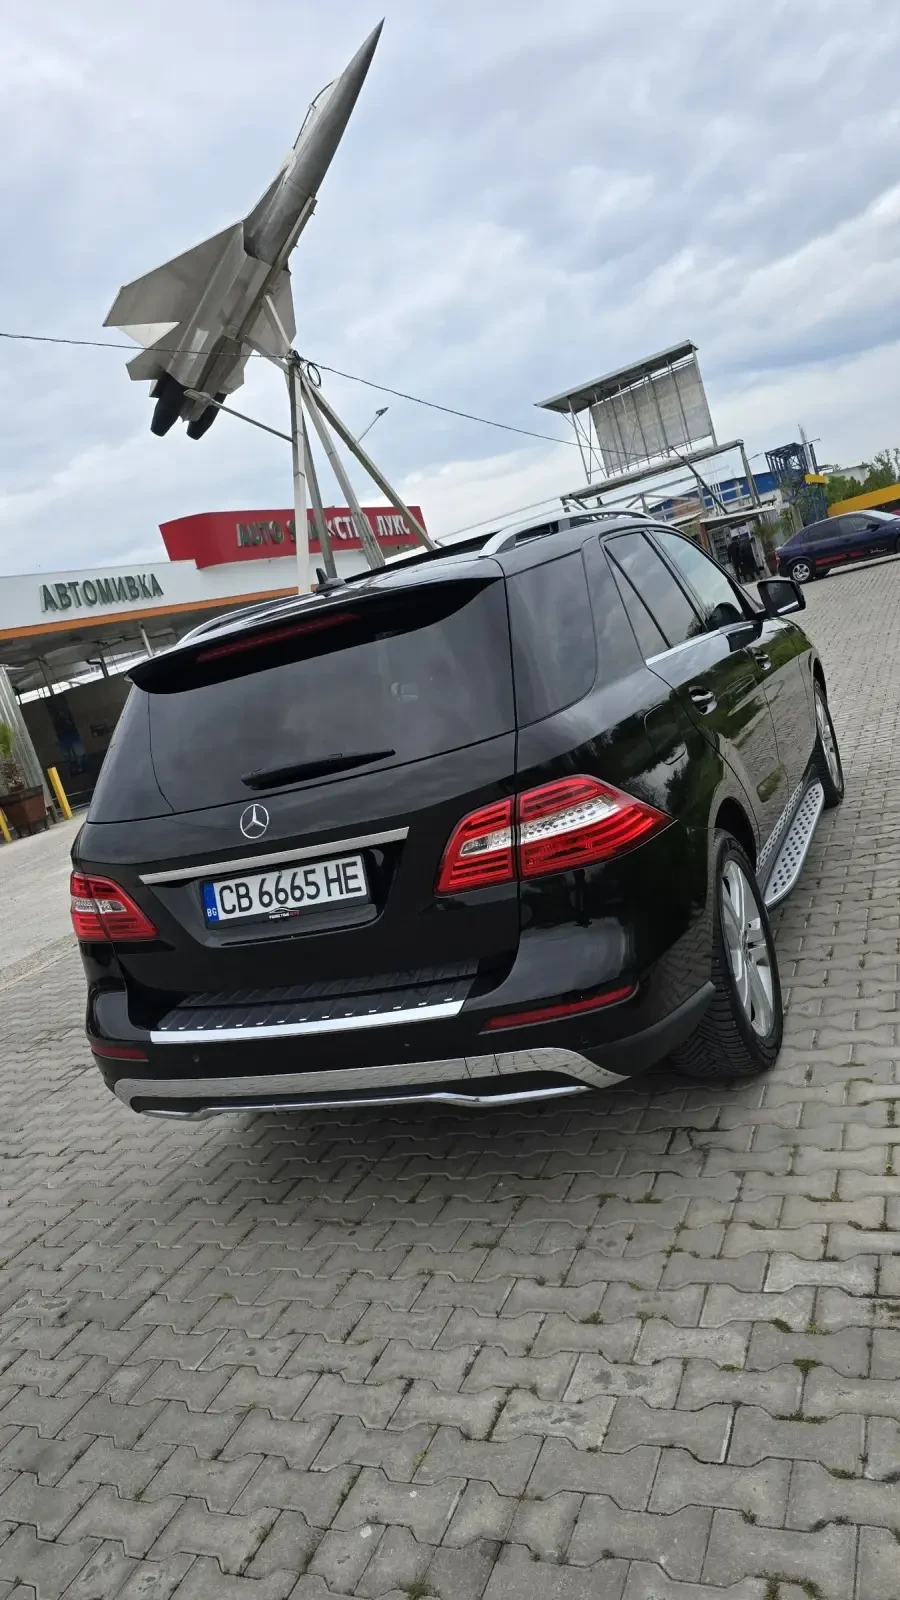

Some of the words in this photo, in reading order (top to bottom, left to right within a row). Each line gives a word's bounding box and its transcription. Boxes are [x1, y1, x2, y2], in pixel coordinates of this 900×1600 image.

[236, 520, 283, 546] AUTO
[376, 515, 410, 537] ЛУКС
[38, 573, 164, 612] АВТОМИВКА
[218, 882, 253, 915] CB
[258, 868, 320, 908] 6665
[324, 861, 362, 897] HE
[206, 907, 218, 918] BG
